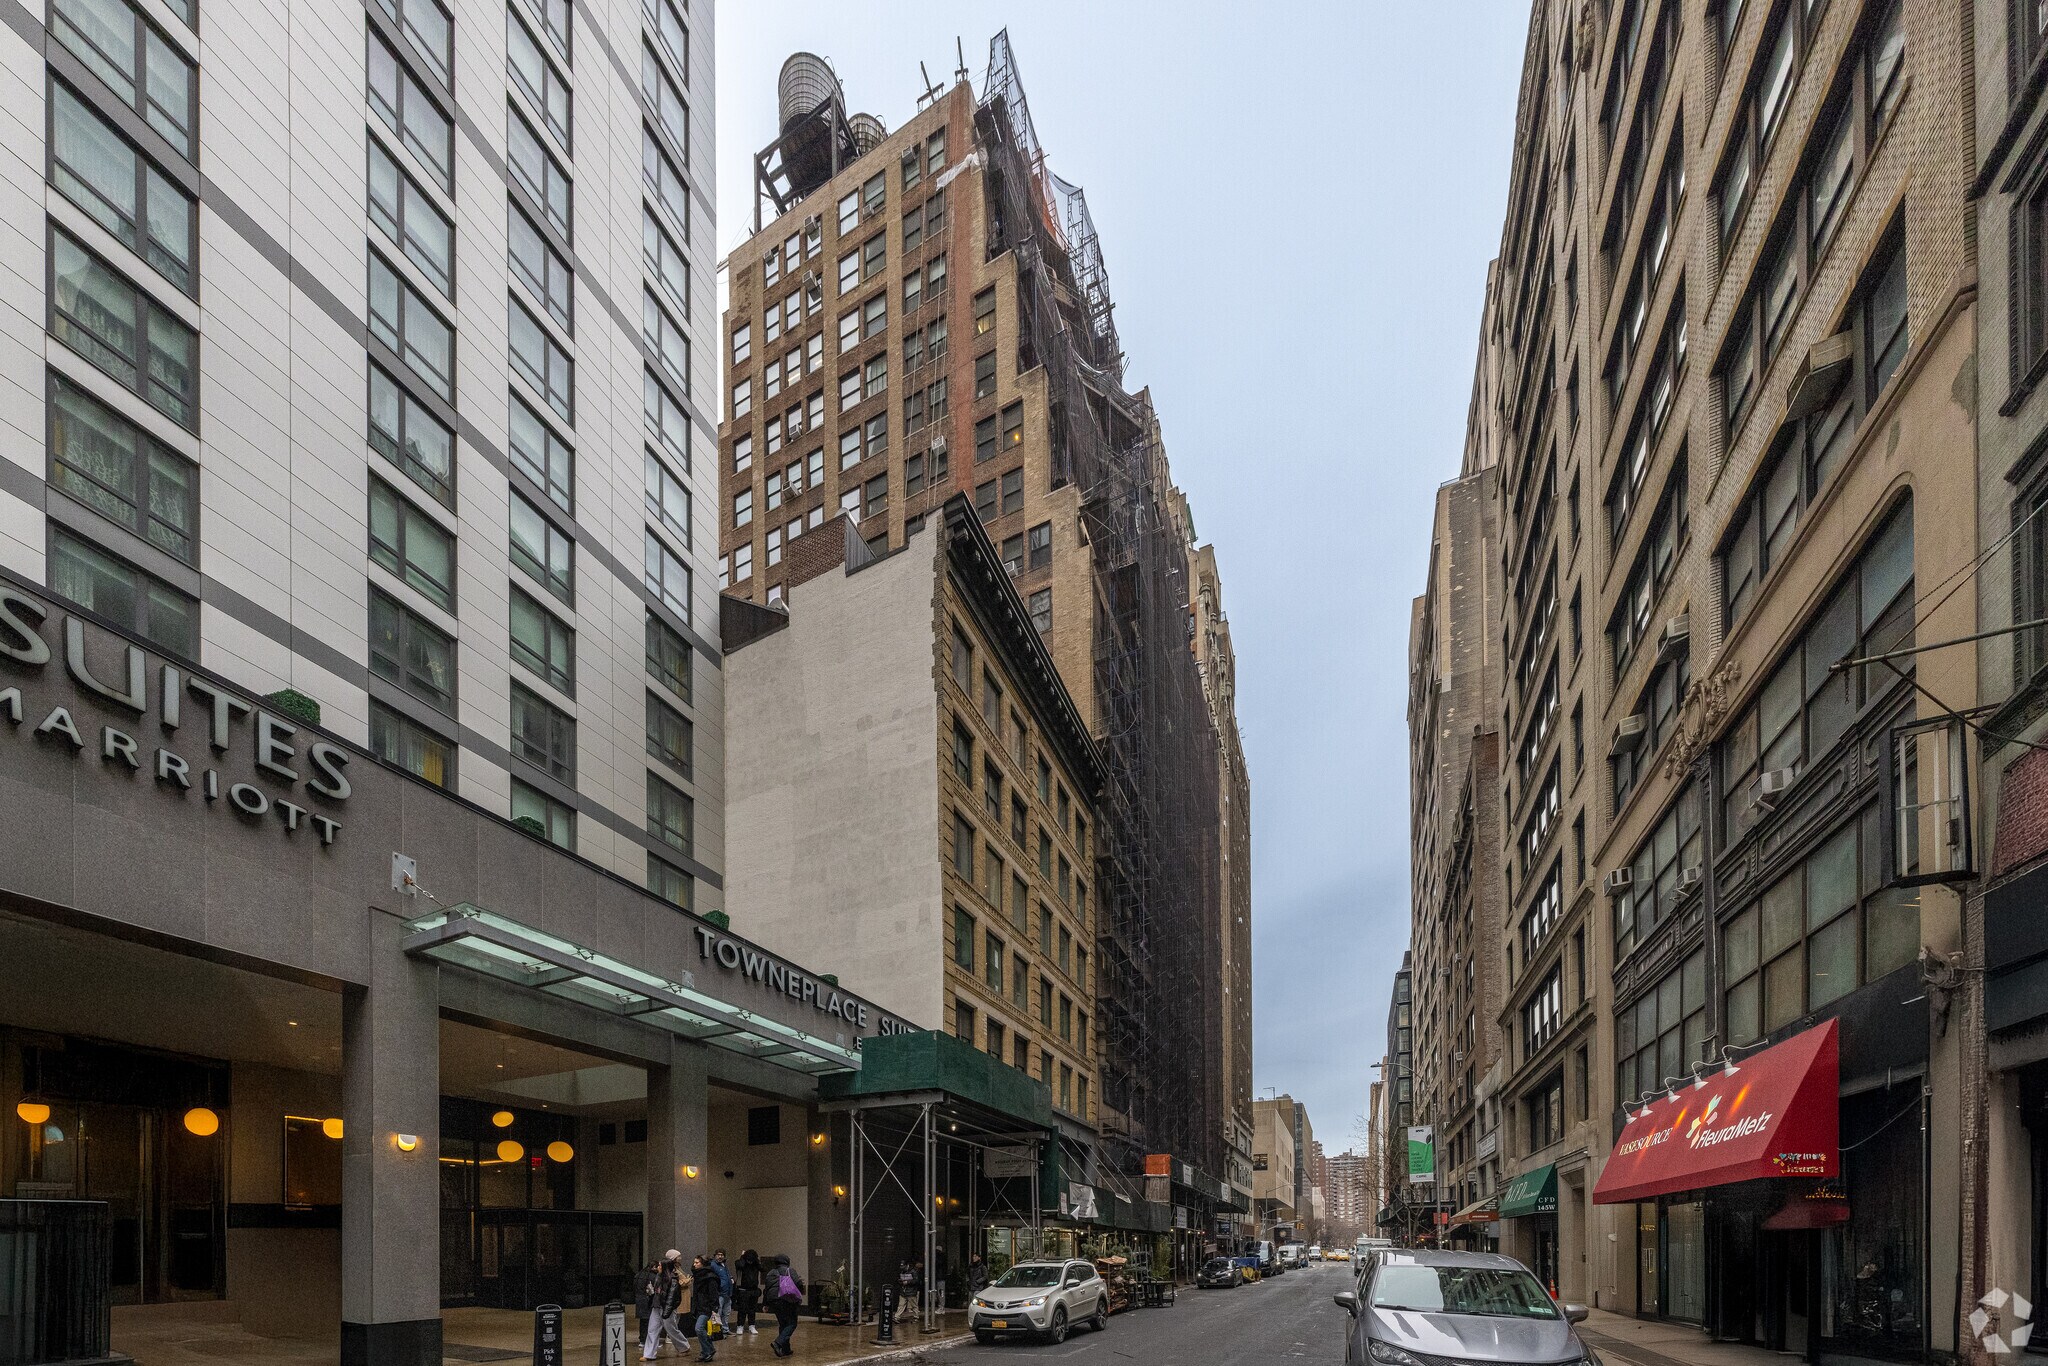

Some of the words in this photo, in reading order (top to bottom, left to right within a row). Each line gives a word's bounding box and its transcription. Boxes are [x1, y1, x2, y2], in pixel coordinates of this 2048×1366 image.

[0, 585, 353, 801] SUITES
[695, 926, 868, 1029] TOWNEPLACE
[1694, 1111, 1773, 1150] FleuraMetz
[611, 1327, 622, 1366] VAL
